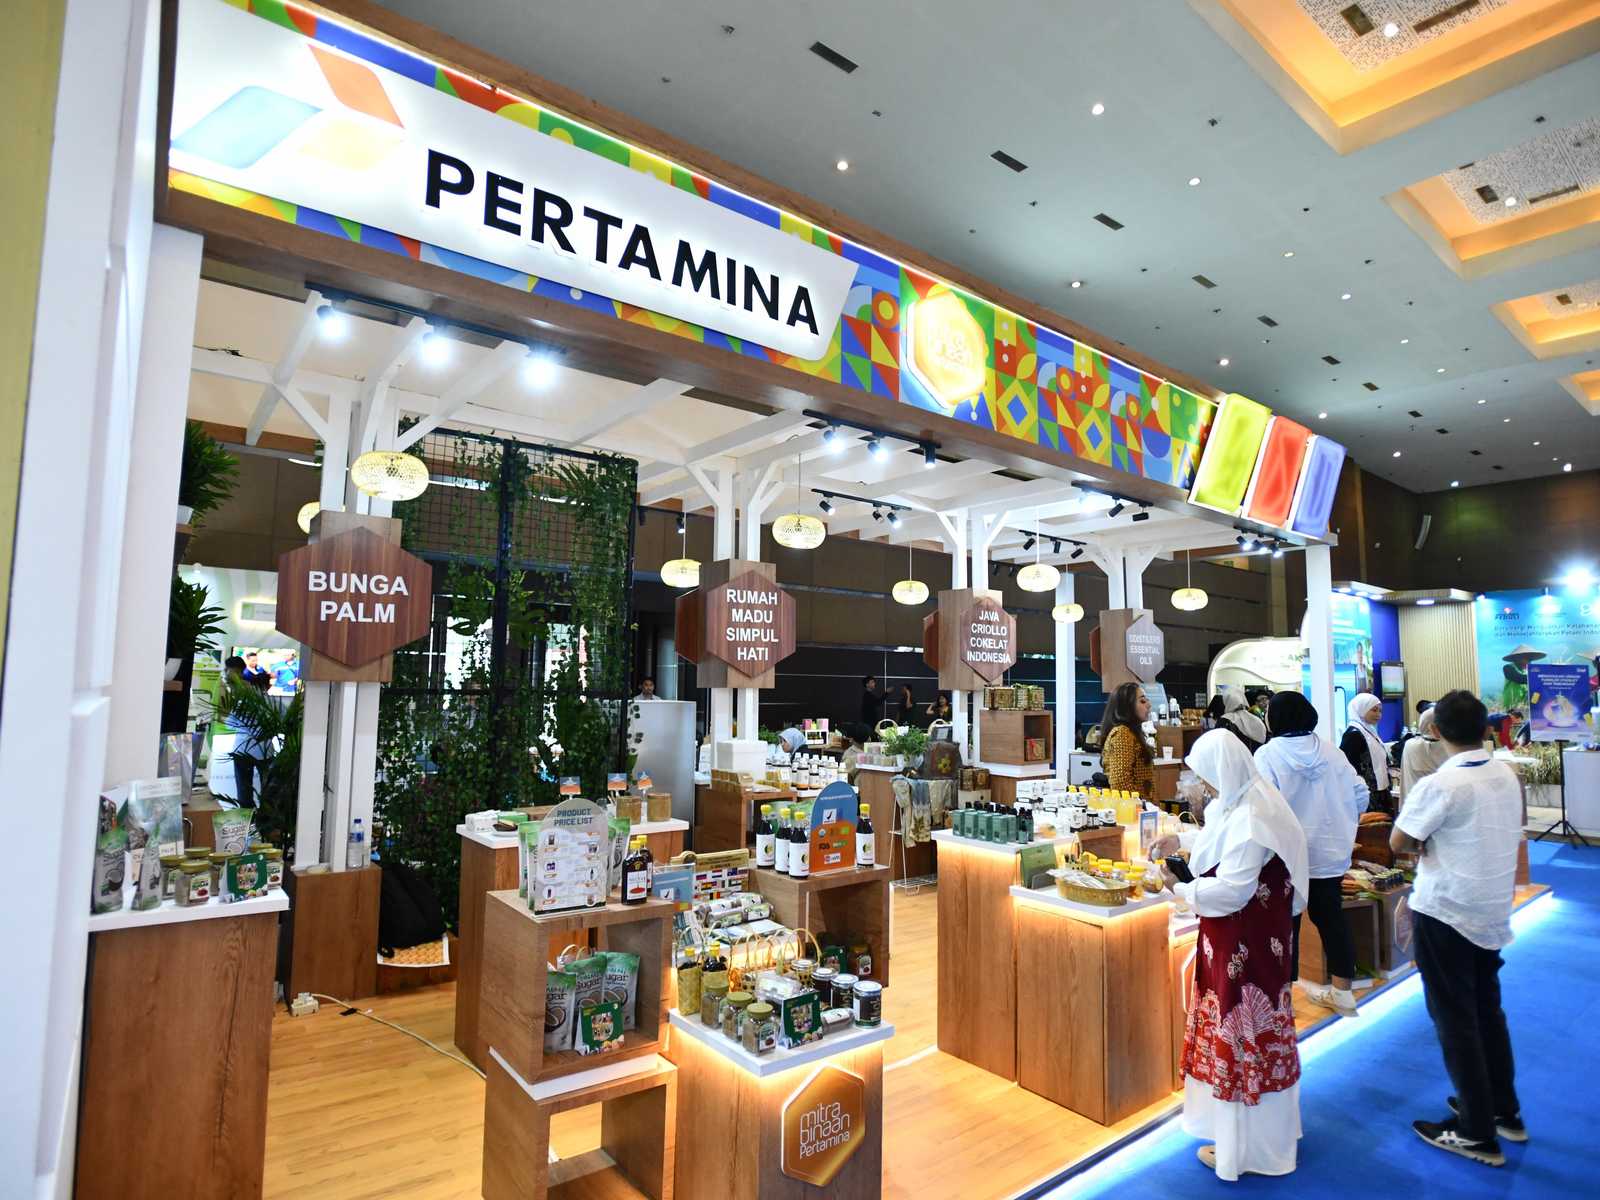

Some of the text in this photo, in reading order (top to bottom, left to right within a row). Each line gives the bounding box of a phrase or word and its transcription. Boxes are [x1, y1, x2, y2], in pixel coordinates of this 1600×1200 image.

[425, 149, 820, 336] PERTAMINA
[308, 570, 409, 596] BUNGA
[726, 588, 778, 605] RUMAH
[320, 600, 396, 624] PALM
[731, 608, 773, 624] MADU
[978, 610, 1000, 622] JAVA
[725, 627, 779, 643] SIMPUL
[971, 623, 1008, 636] CRIOLLO
[970, 637, 1008, 649] COKELAT
[737, 647, 769, 661] HATI
[966, 650, 1012, 664] INDONESIA
[556, 808, 592, 817] PRODUCT
[553, 818, 576, 826] PRICE
[800, 1102, 841, 1127] mitra
[800, 1113, 850, 1146] binaan
[799, 1130, 850, 1160] Pertamina
